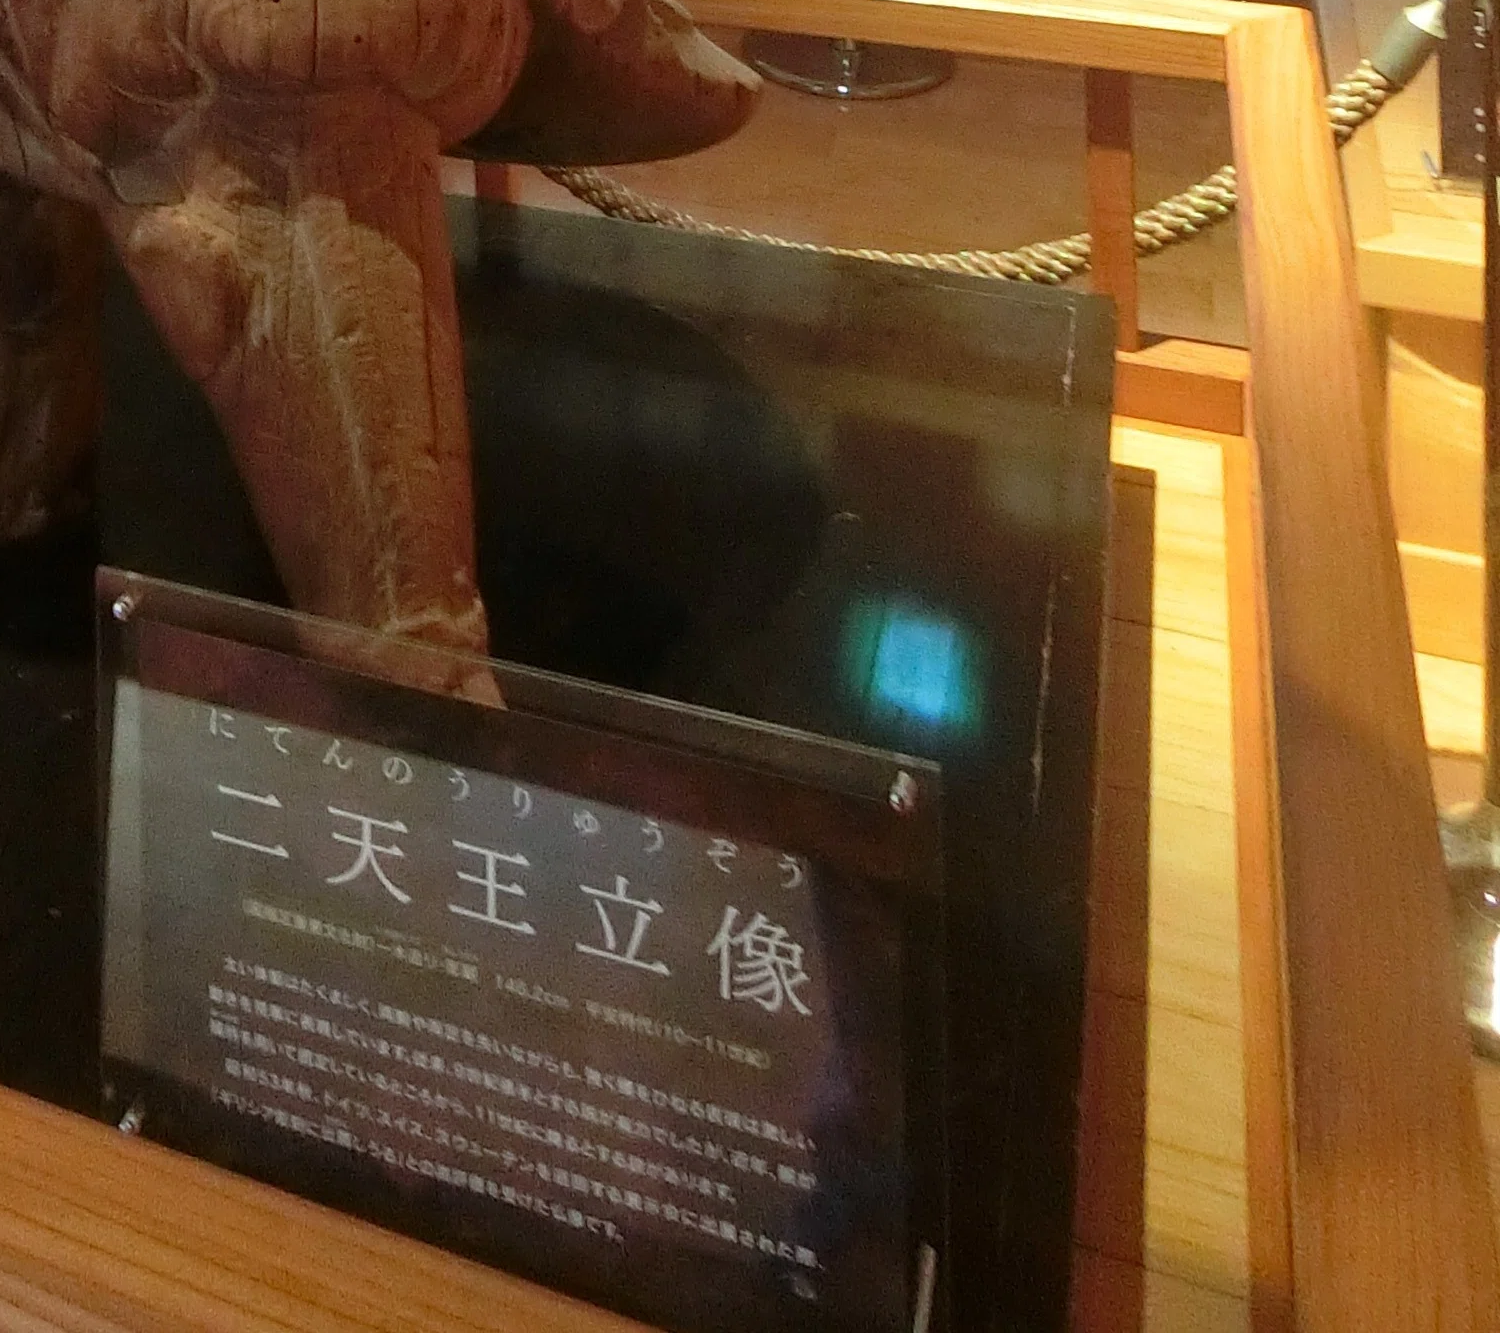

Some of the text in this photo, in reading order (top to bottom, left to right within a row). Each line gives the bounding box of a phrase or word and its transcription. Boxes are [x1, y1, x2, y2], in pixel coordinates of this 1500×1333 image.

[210, 783, 813, 1017] 二天王立像
